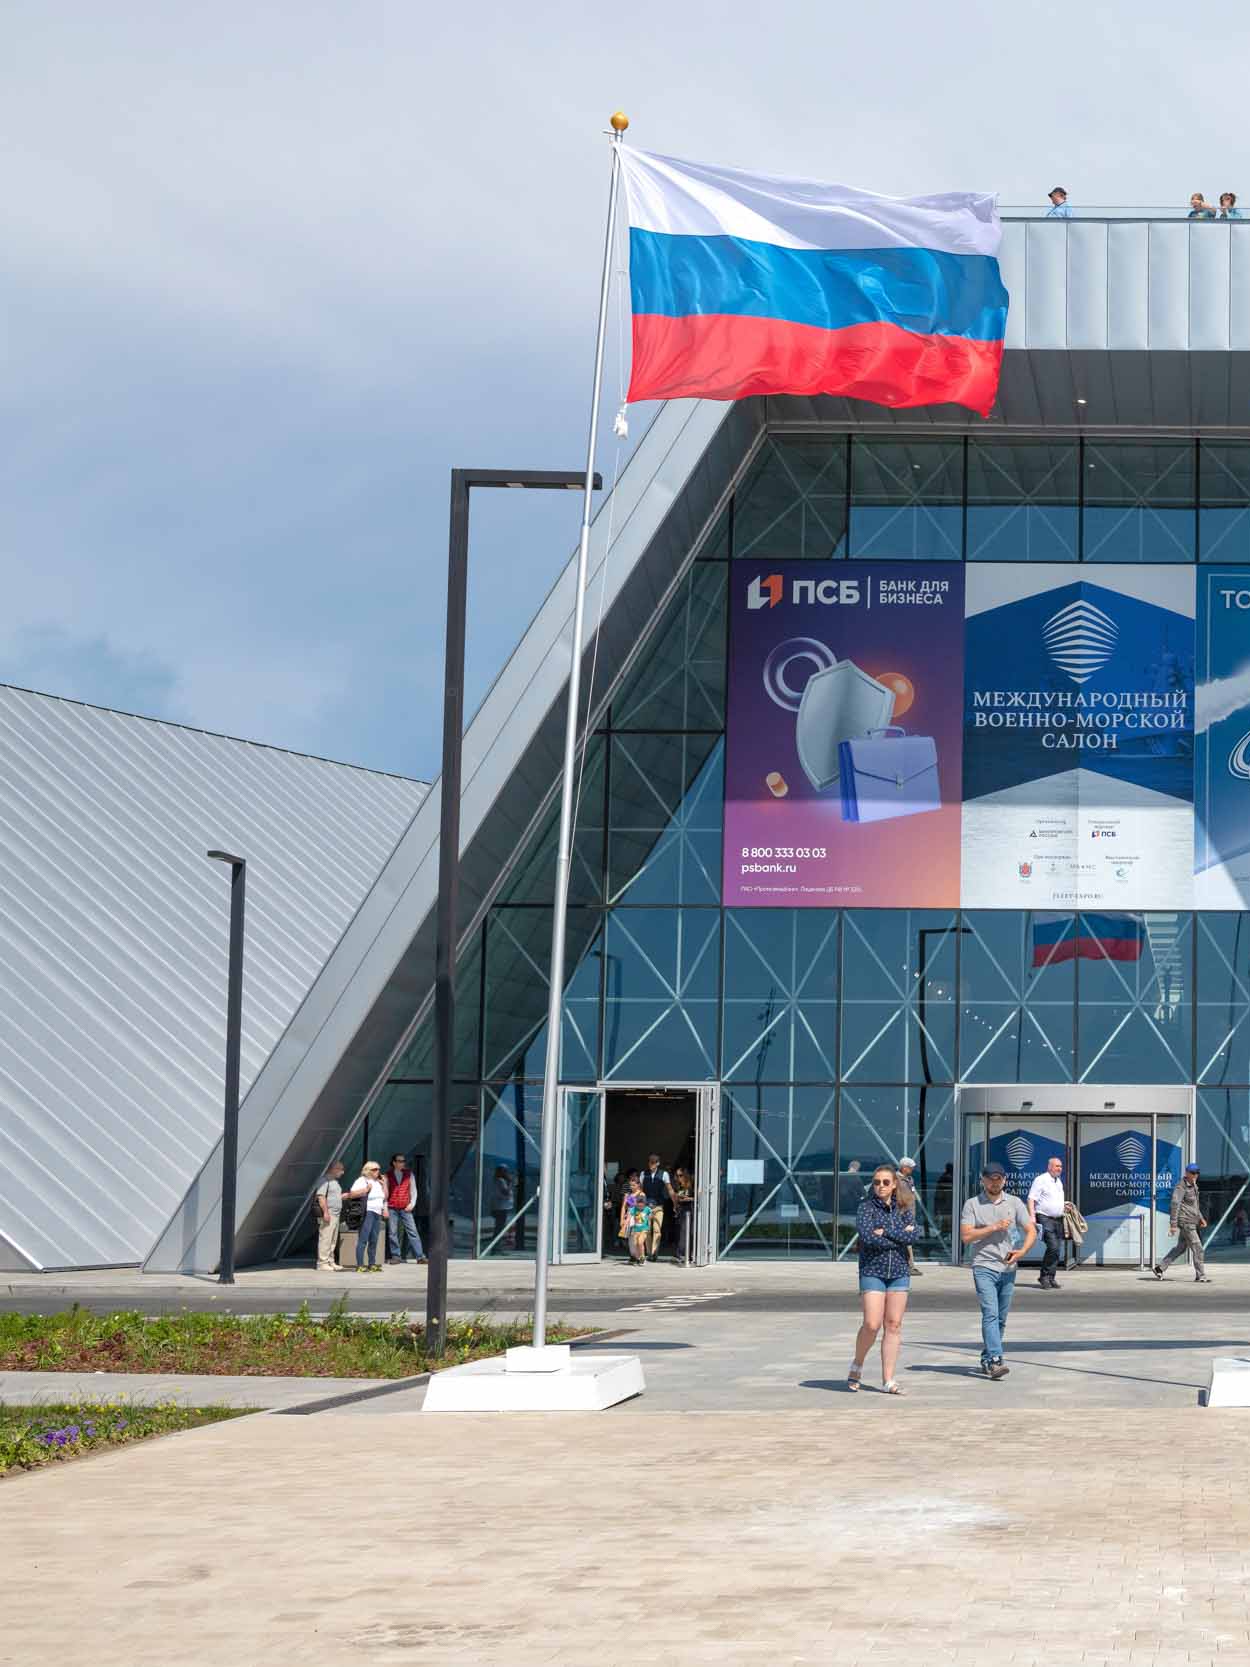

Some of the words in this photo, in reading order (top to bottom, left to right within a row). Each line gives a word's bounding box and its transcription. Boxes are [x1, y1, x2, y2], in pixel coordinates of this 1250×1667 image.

[792, 579, 860, 605] ПСБ
[879, 580, 917, 592] БАНК
[919, 580, 949, 594] ДЛЯ
[879, 593, 943, 605] БИЗНЕСА
[973, 689, 1187, 710] МЕЖДУНАРОДНЫЙ
[975, 710, 1185, 728] ВОЕННО-МОРСКОЙ
[1042, 733, 1118, 749] САЛОН
[741, 847, 750, 858] 8
[750, 847, 773, 858] 800
[774, 847, 794, 858] 333
[795, 847, 811, 858] 03
[811, 847, 827, 858] 03
[741, 863, 797, 875] psbank.ru
[1089, 1172, 1173, 1181] МЕЖДУНАРОДЫЙ
[1115, 1189, 1146, 1197] САЛОН
